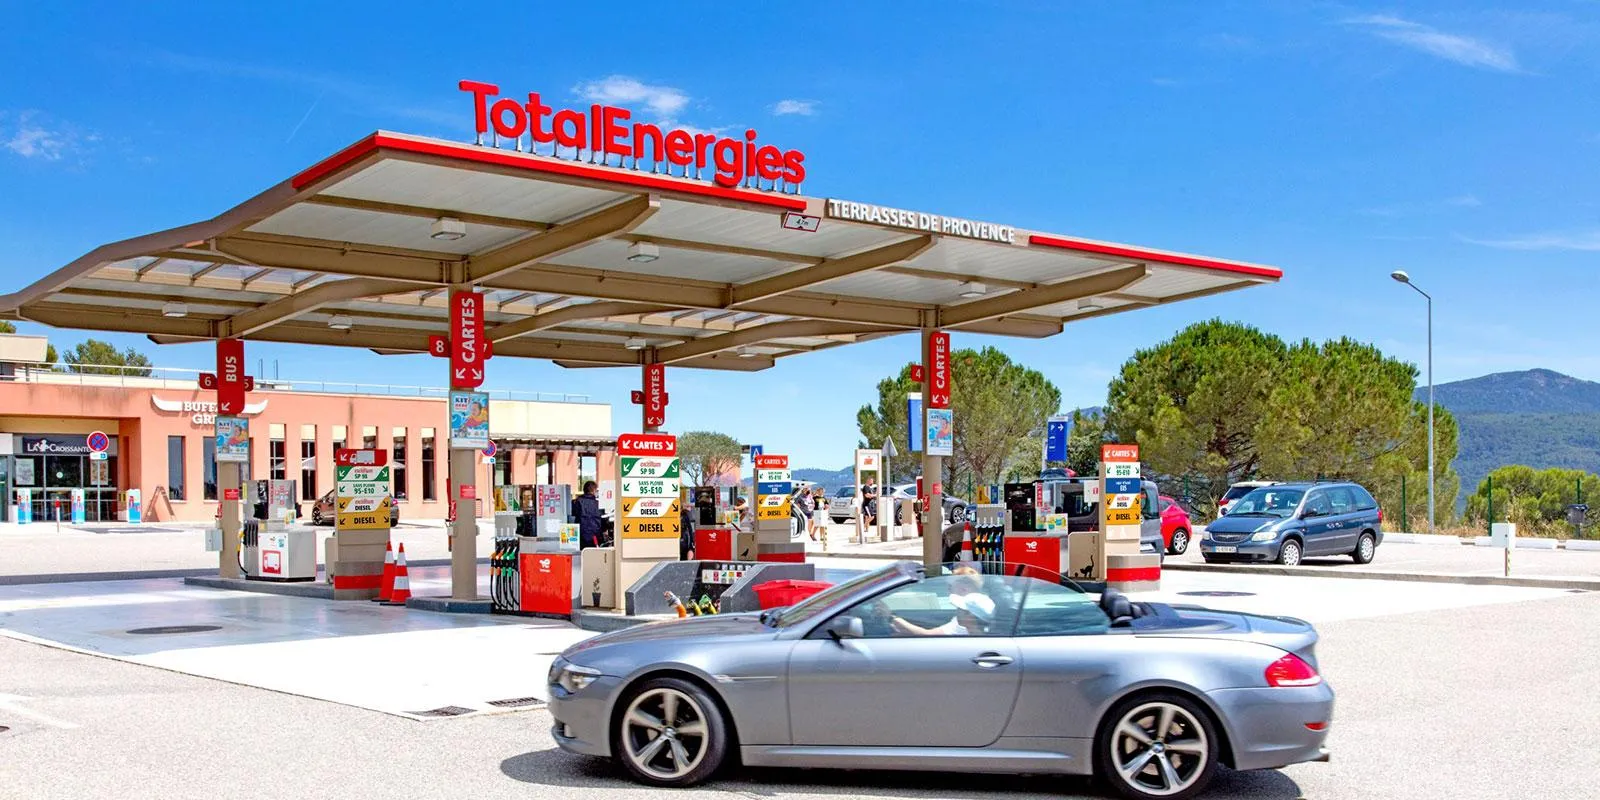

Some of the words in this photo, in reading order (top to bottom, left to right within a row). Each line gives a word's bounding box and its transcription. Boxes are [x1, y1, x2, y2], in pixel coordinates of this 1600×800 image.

[458, 79, 806, 187] TotalEnergies
[829, 198, 915, 228] TERRASSES
[919, 213, 938, 231] DE
[941, 216, 1015, 242] PROVENCE
[461, 298, 475, 363] CARTES
[436, 340, 444, 353] 8
[936, 336, 945, 389] CARTES
[225, 355, 237, 382] BUS
[915, 368, 921, 379] 4
[204, 376, 212, 386] 6
[651, 369, 660, 411] CARTES
[635, 393, 640, 402] 2
[183, 401, 218, 412] BUFF
[633, 441, 663, 450] CARTES
[354, 487, 375, 495] 95-E10
[639, 486, 663, 494] 95-E10
[640, 508, 659, 516] DIESEL
[639, 523, 664, 532] DIESEL
